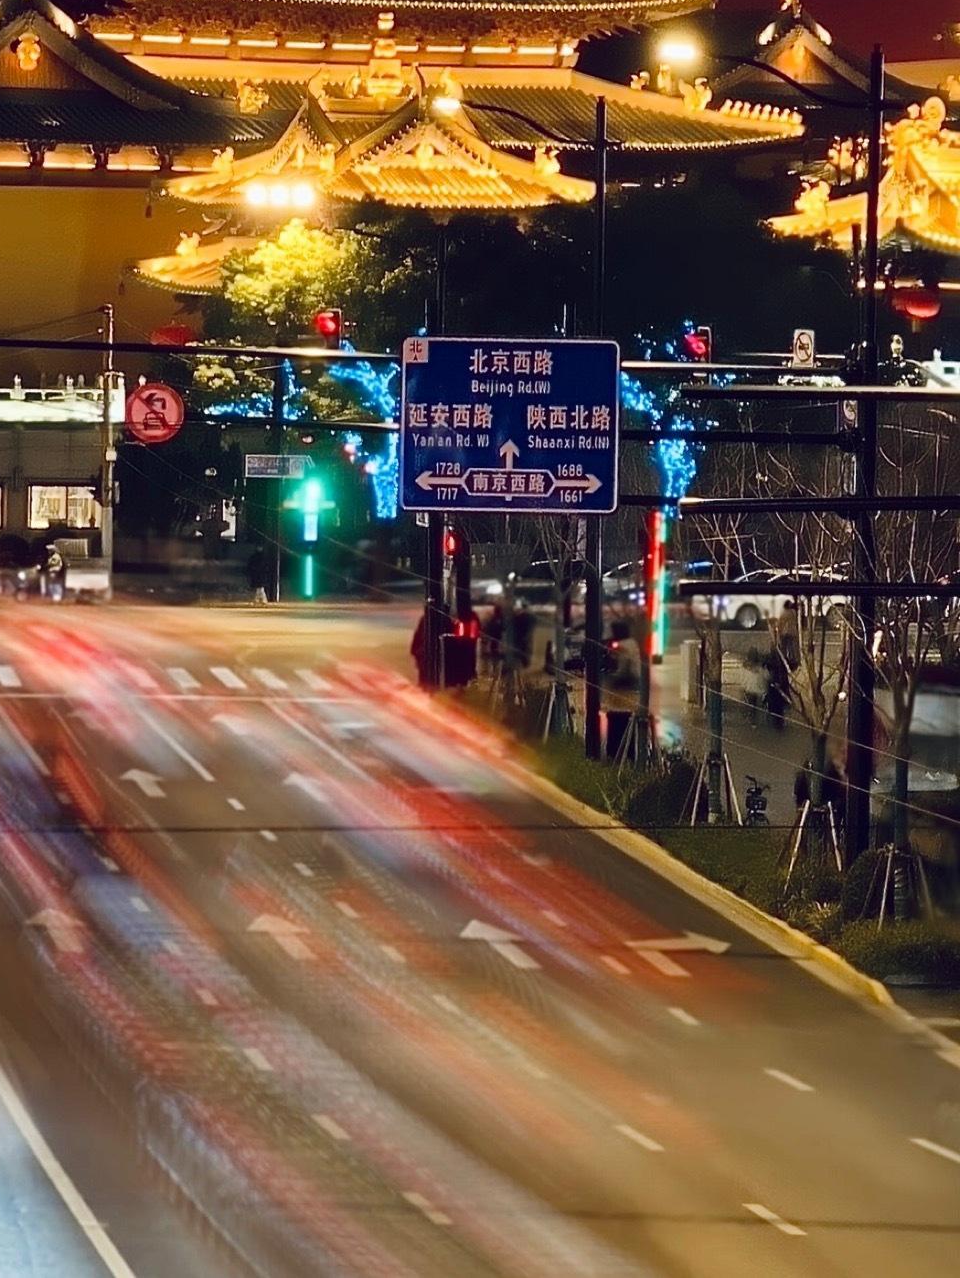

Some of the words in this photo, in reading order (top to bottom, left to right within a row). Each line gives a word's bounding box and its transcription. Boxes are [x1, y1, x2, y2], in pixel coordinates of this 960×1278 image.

[409, 340, 423, 353] 北
[469, 348, 554, 376] 北京西路
[471, 379, 514, 398] Beijing
[408, 402, 494, 430] 延安西路
[526, 404, 611, 431] 陕西北路
[412, 433, 452, 447] Yan'an
[527, 435, 575, 449] Shaanxi
[435, 462, 461, 475] 1728
[557, 464, 583, 477] 1688
[472, 472, 546, 493] 南京西路
[437, 487, 458, 501] 1717
[559, 489, 583, 503] 1661
